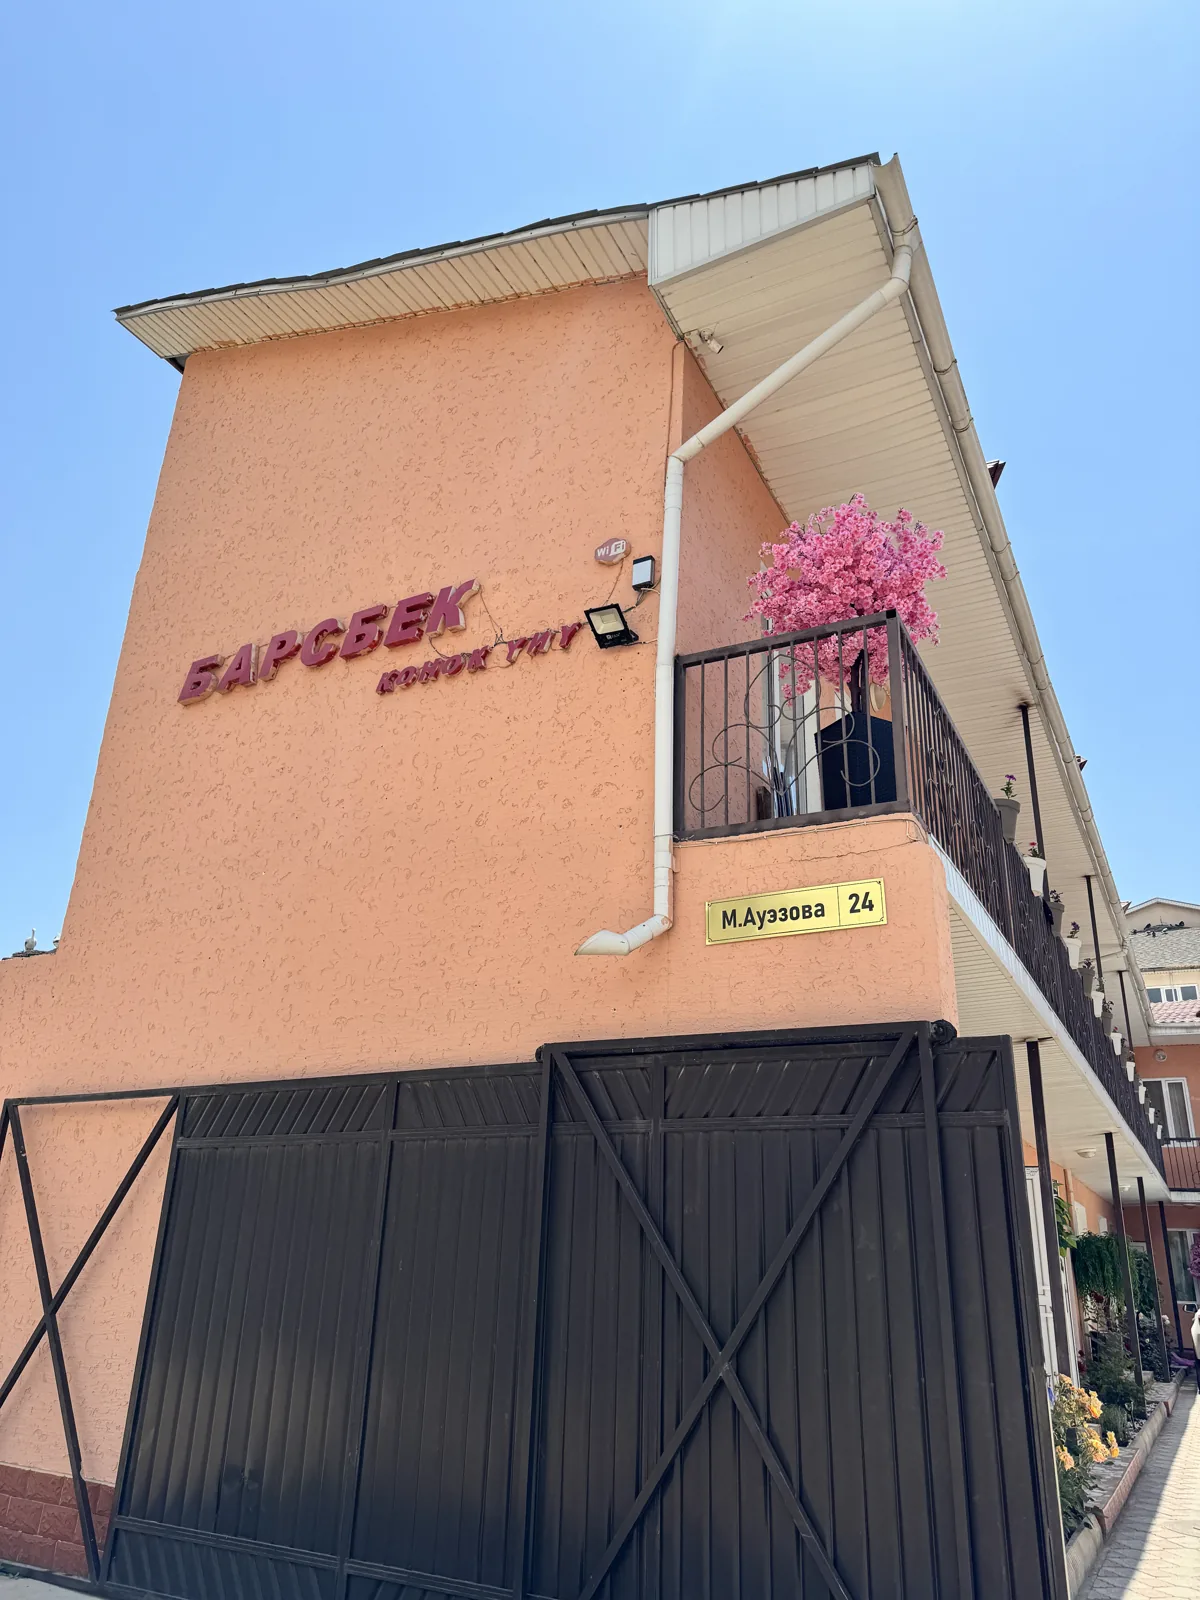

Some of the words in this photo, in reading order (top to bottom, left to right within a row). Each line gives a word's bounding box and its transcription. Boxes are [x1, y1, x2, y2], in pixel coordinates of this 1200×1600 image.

[177, 579, 481, 705] БАРСБЕК
[376, 645, 493, 695] КОНОК
[721, 902, 825, 930] М.Ауэзова
[848, 891, 874, 914] 24
